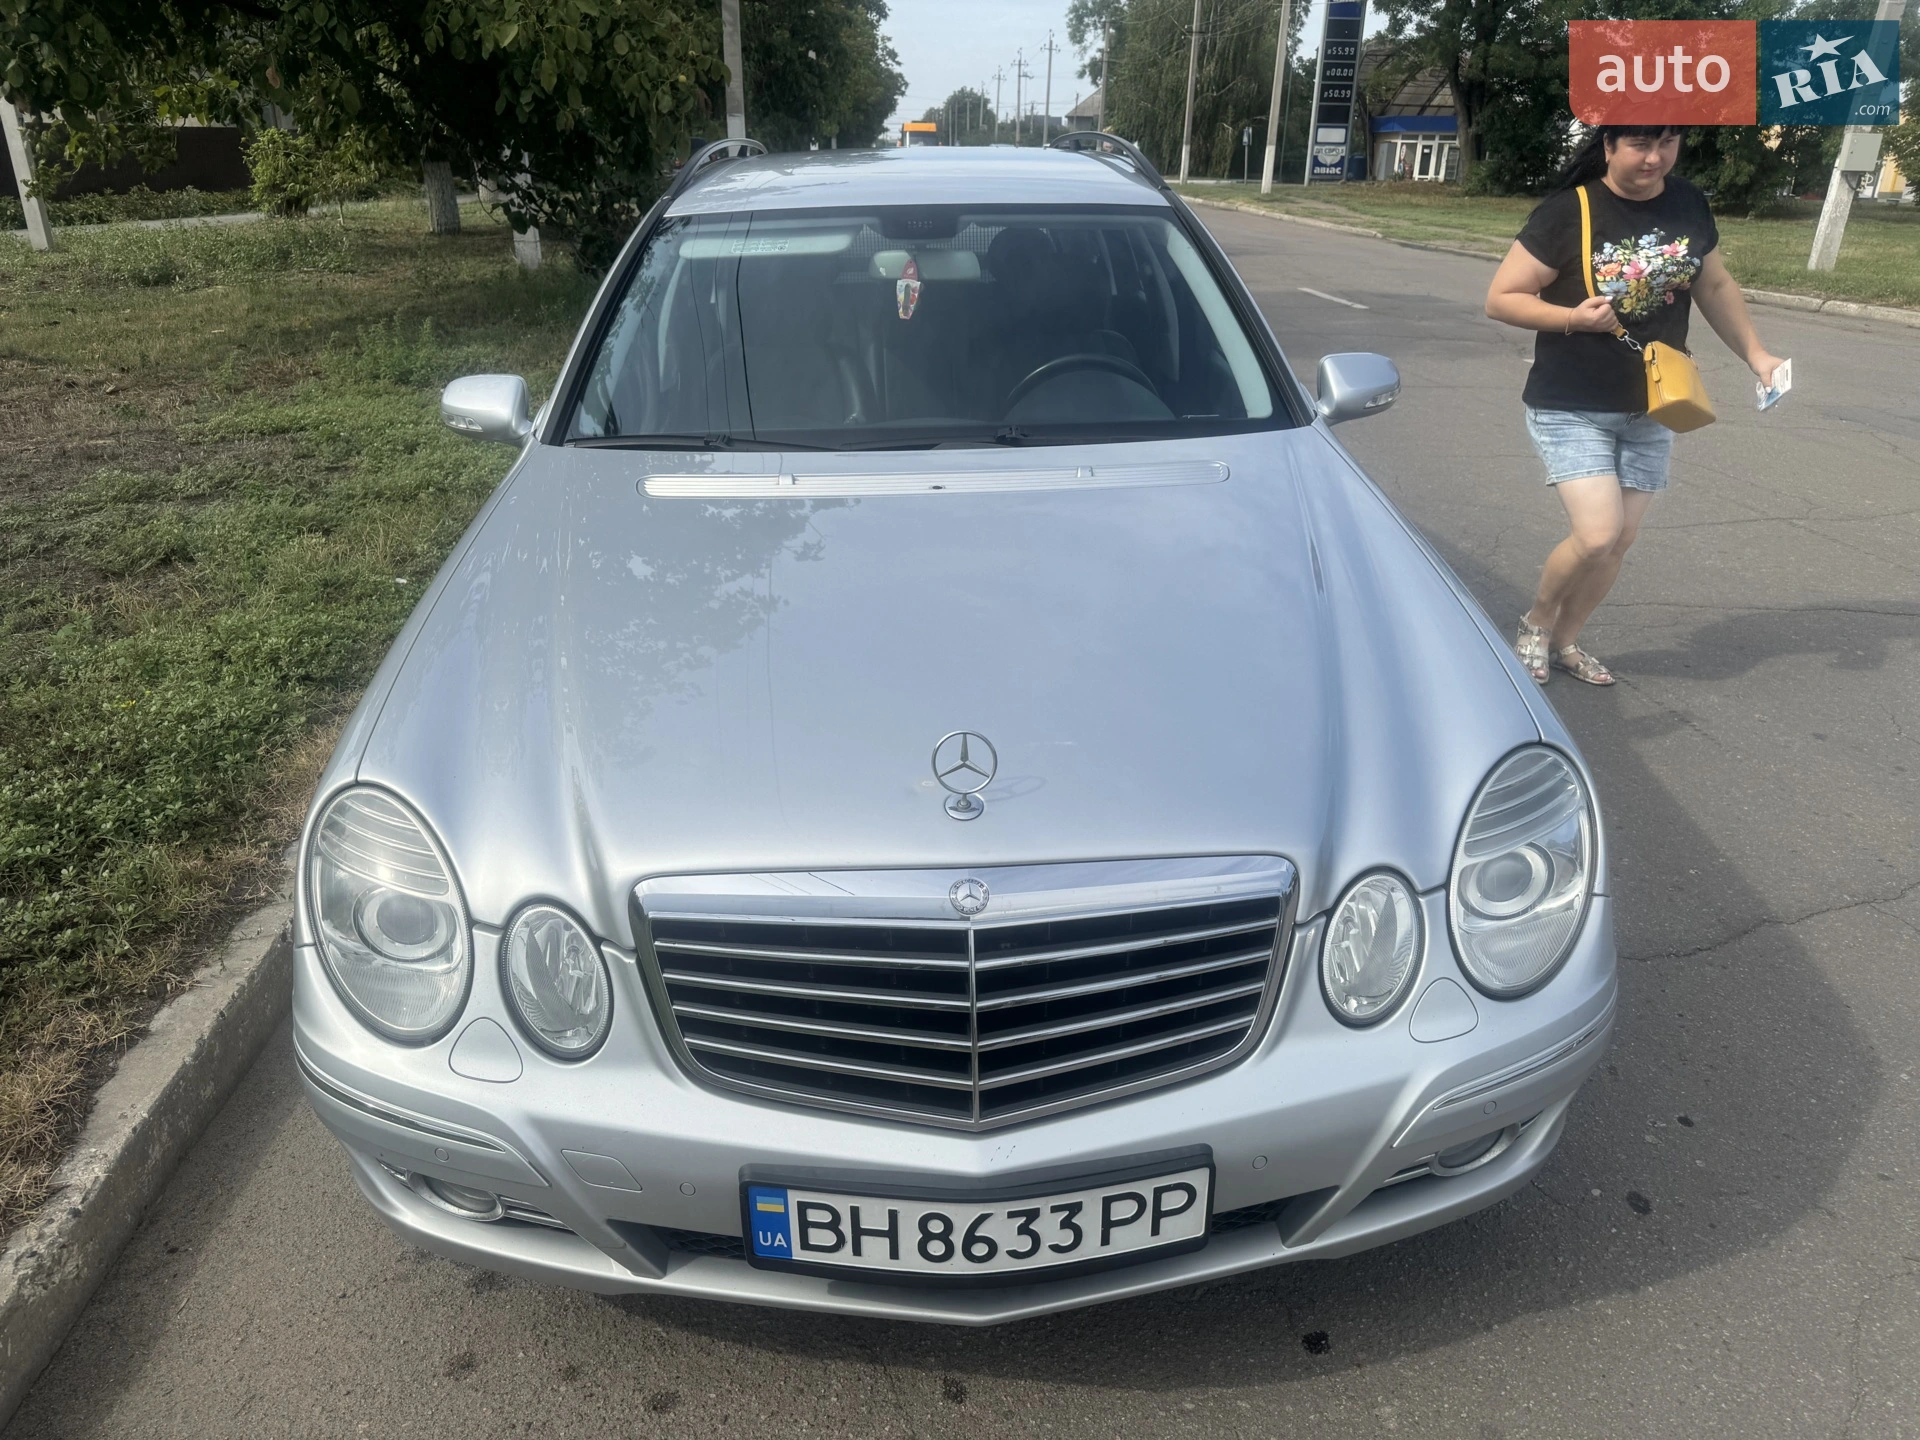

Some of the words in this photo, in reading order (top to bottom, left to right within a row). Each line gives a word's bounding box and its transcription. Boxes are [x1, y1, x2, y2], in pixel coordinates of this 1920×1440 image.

[758, 1230, 787, 1248] UA
[796, 1199, 900, 1260] BH
[916, 1200, 1083, 1263] 8633
[1100, 1181, 1197, 1247] PP
